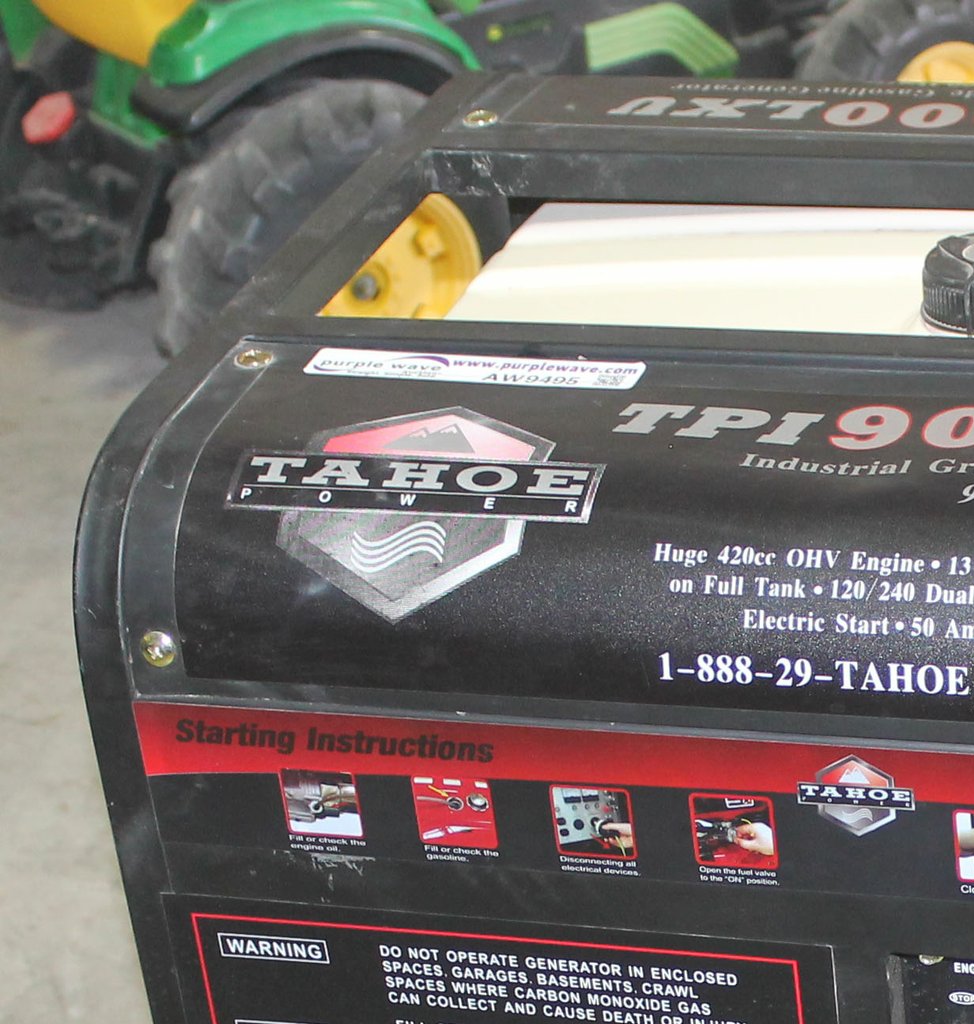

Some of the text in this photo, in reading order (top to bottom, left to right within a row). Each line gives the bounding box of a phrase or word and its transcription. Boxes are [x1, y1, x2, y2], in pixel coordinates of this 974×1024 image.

[453, 358, 638, 376] www.purplewave.com
[482, 373, 580, 386] AW9495
[250, 455, 590, 496] TAHOE
[738, 452, 912, 477] Industrial
[653, 543, 708, 569] Huge
[717, 545, 776, 567] 420cc
[786, 548, 842, 569] OHV
[850, 550, 925, 577] Engine
[947, 556, 971, 577] 13
[669, 578, 693, 595] on
[702, 575, 745, 596] Full
[754, 577, 806, 599] Tank
[829, 577, 916, 602] 120/240
[657, 652, 971, 697] 1-888-29-TAHOE
[175, 718, 495, 763] Starting Instructions
[800, 784, 912, 802] TAHOE
[226, 938, 323, 960] WARNING
[379, 945, 738, 986] DO NOT OPERATE GENERATOR IN ENCLOSED
[385, 976, 711, 1016] SPACES WHERE CARBON MONOXIDE GAS
[642, 983, 699, 999] CRAWL
[388, 991, 420, 1006] CAN
[426, 994, 497, 1013] COLLECT
[504, 1001, 537, 1016] AND
[543, 1005, 597, 1022] CAUSE
